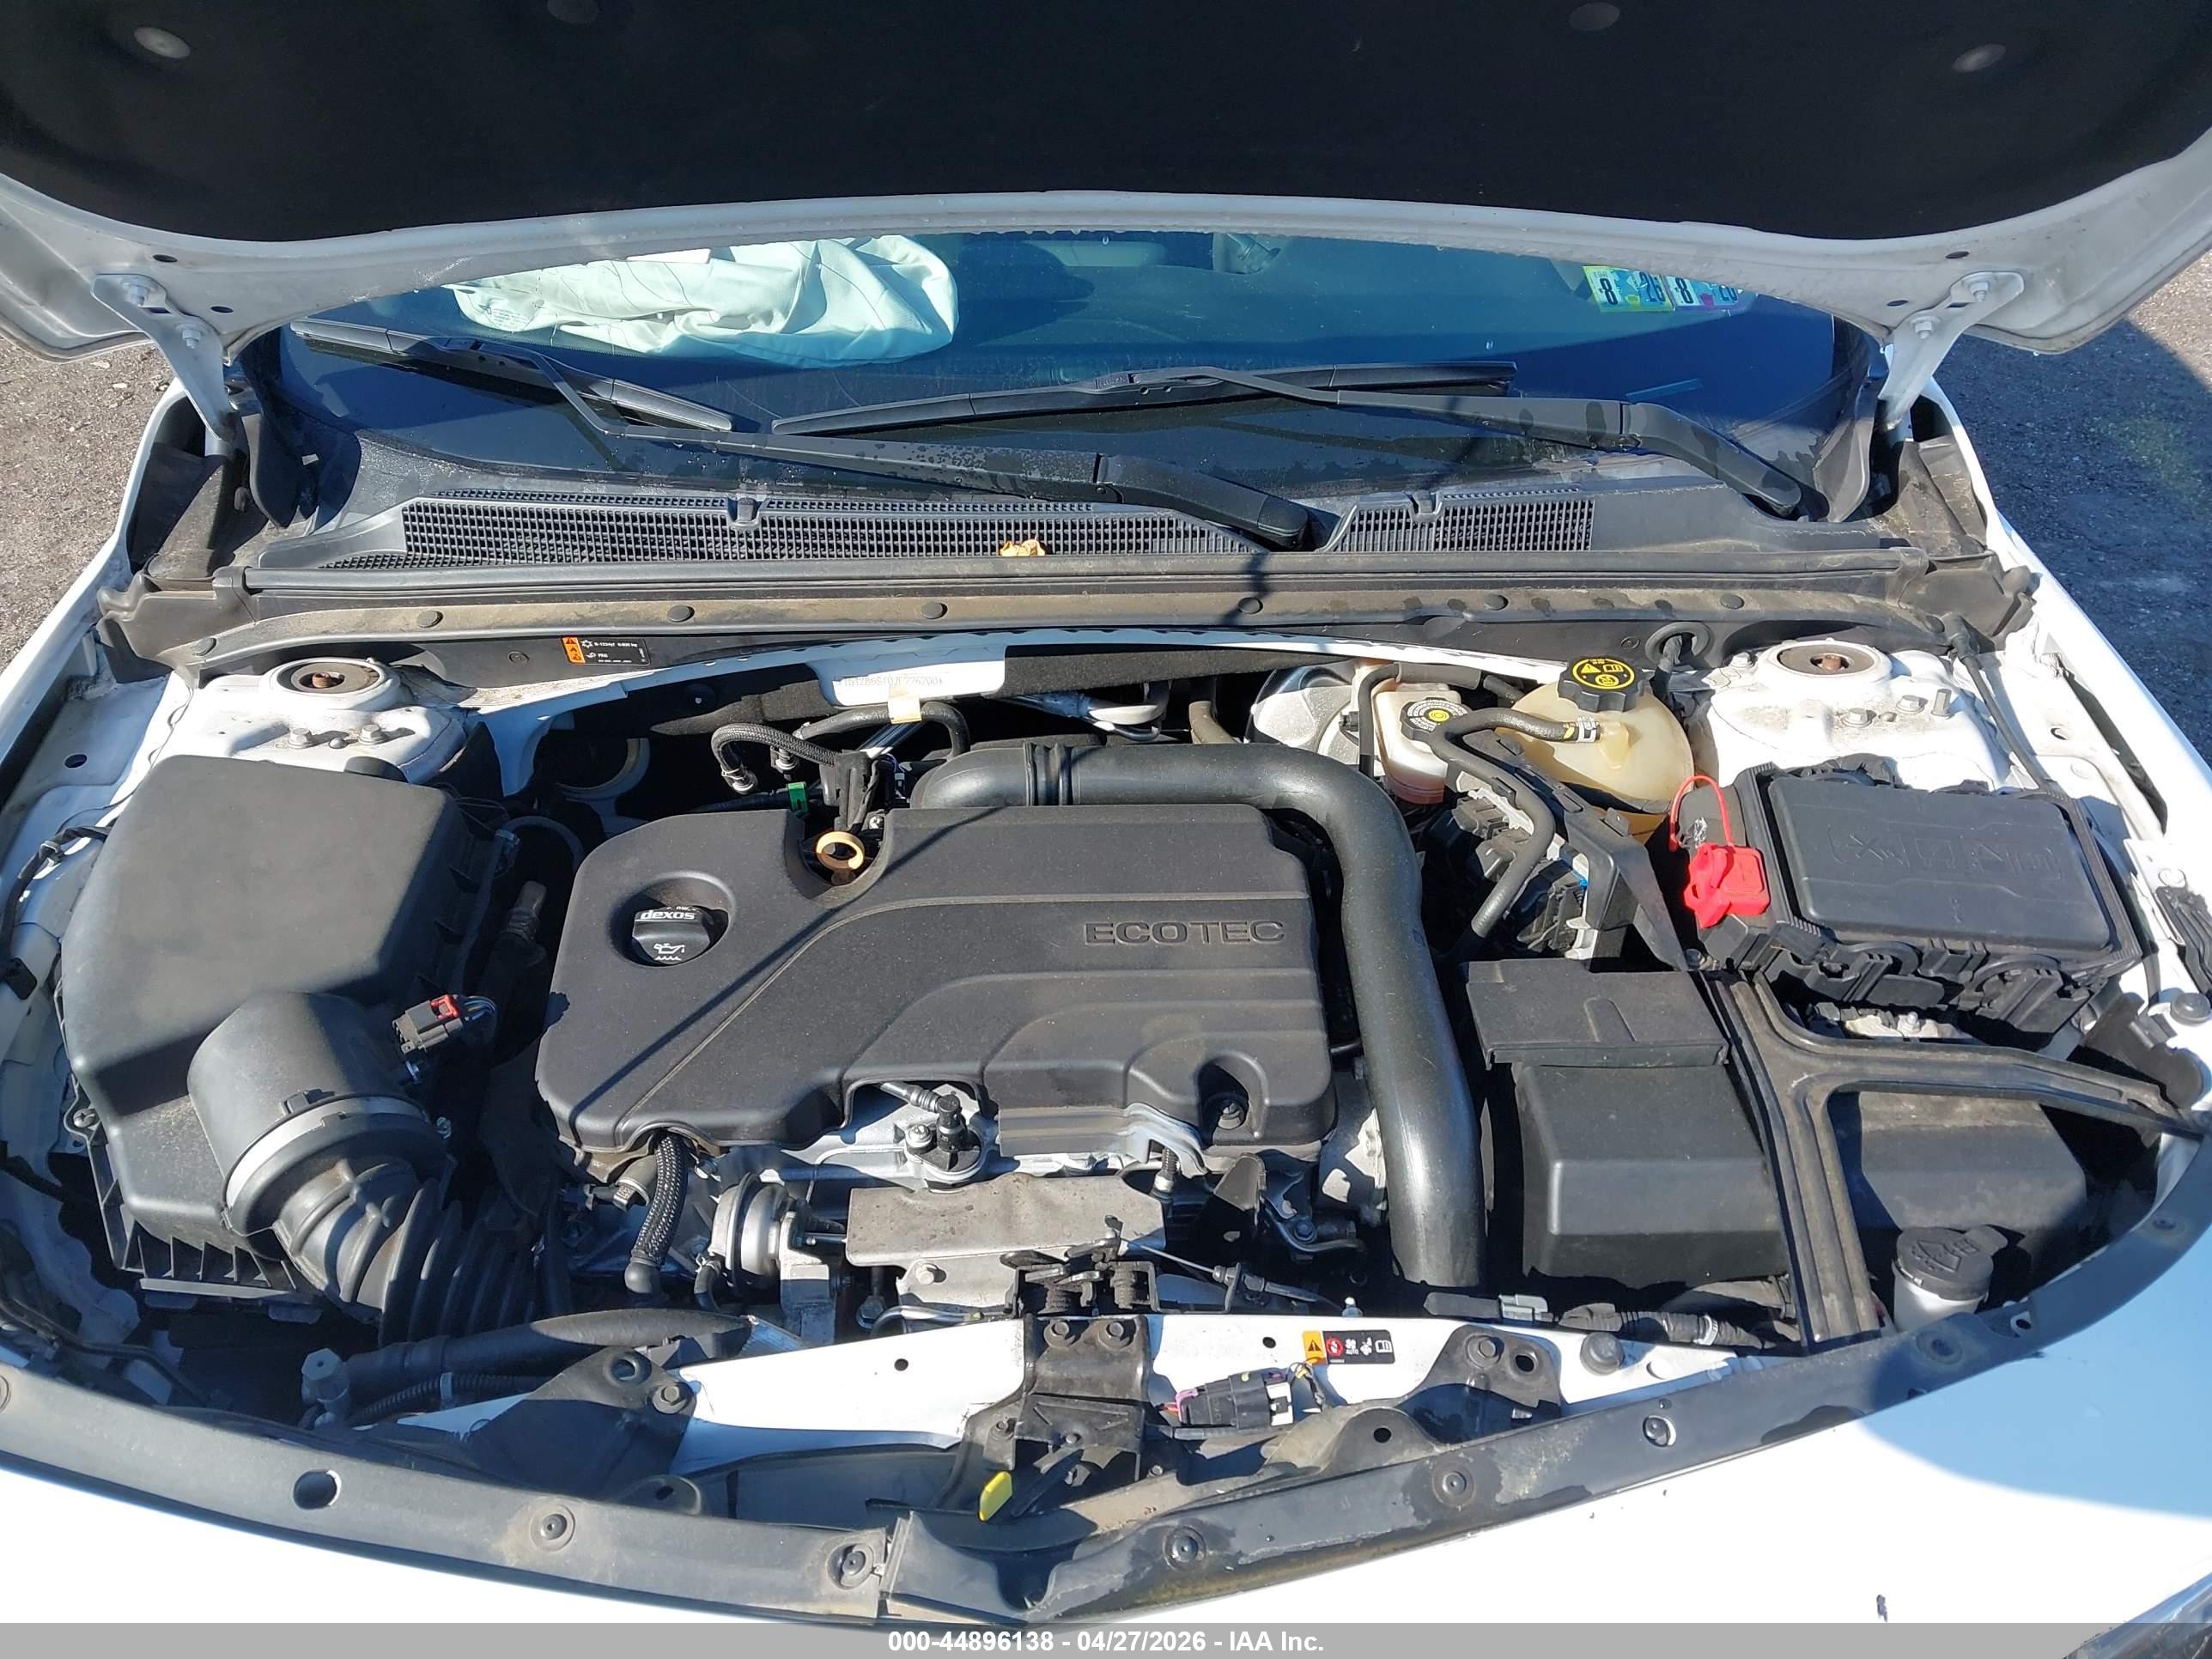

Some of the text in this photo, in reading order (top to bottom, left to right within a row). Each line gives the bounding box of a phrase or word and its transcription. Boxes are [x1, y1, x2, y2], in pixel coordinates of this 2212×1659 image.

[1599, 278, 1619, 305] 8
[1638, 271, 1667, 301] 26
[1675, 276, 1694, 303] 8
[640, 909, 696, 920] dexos
[1084, 920, 1285, 945] ECOTEC
